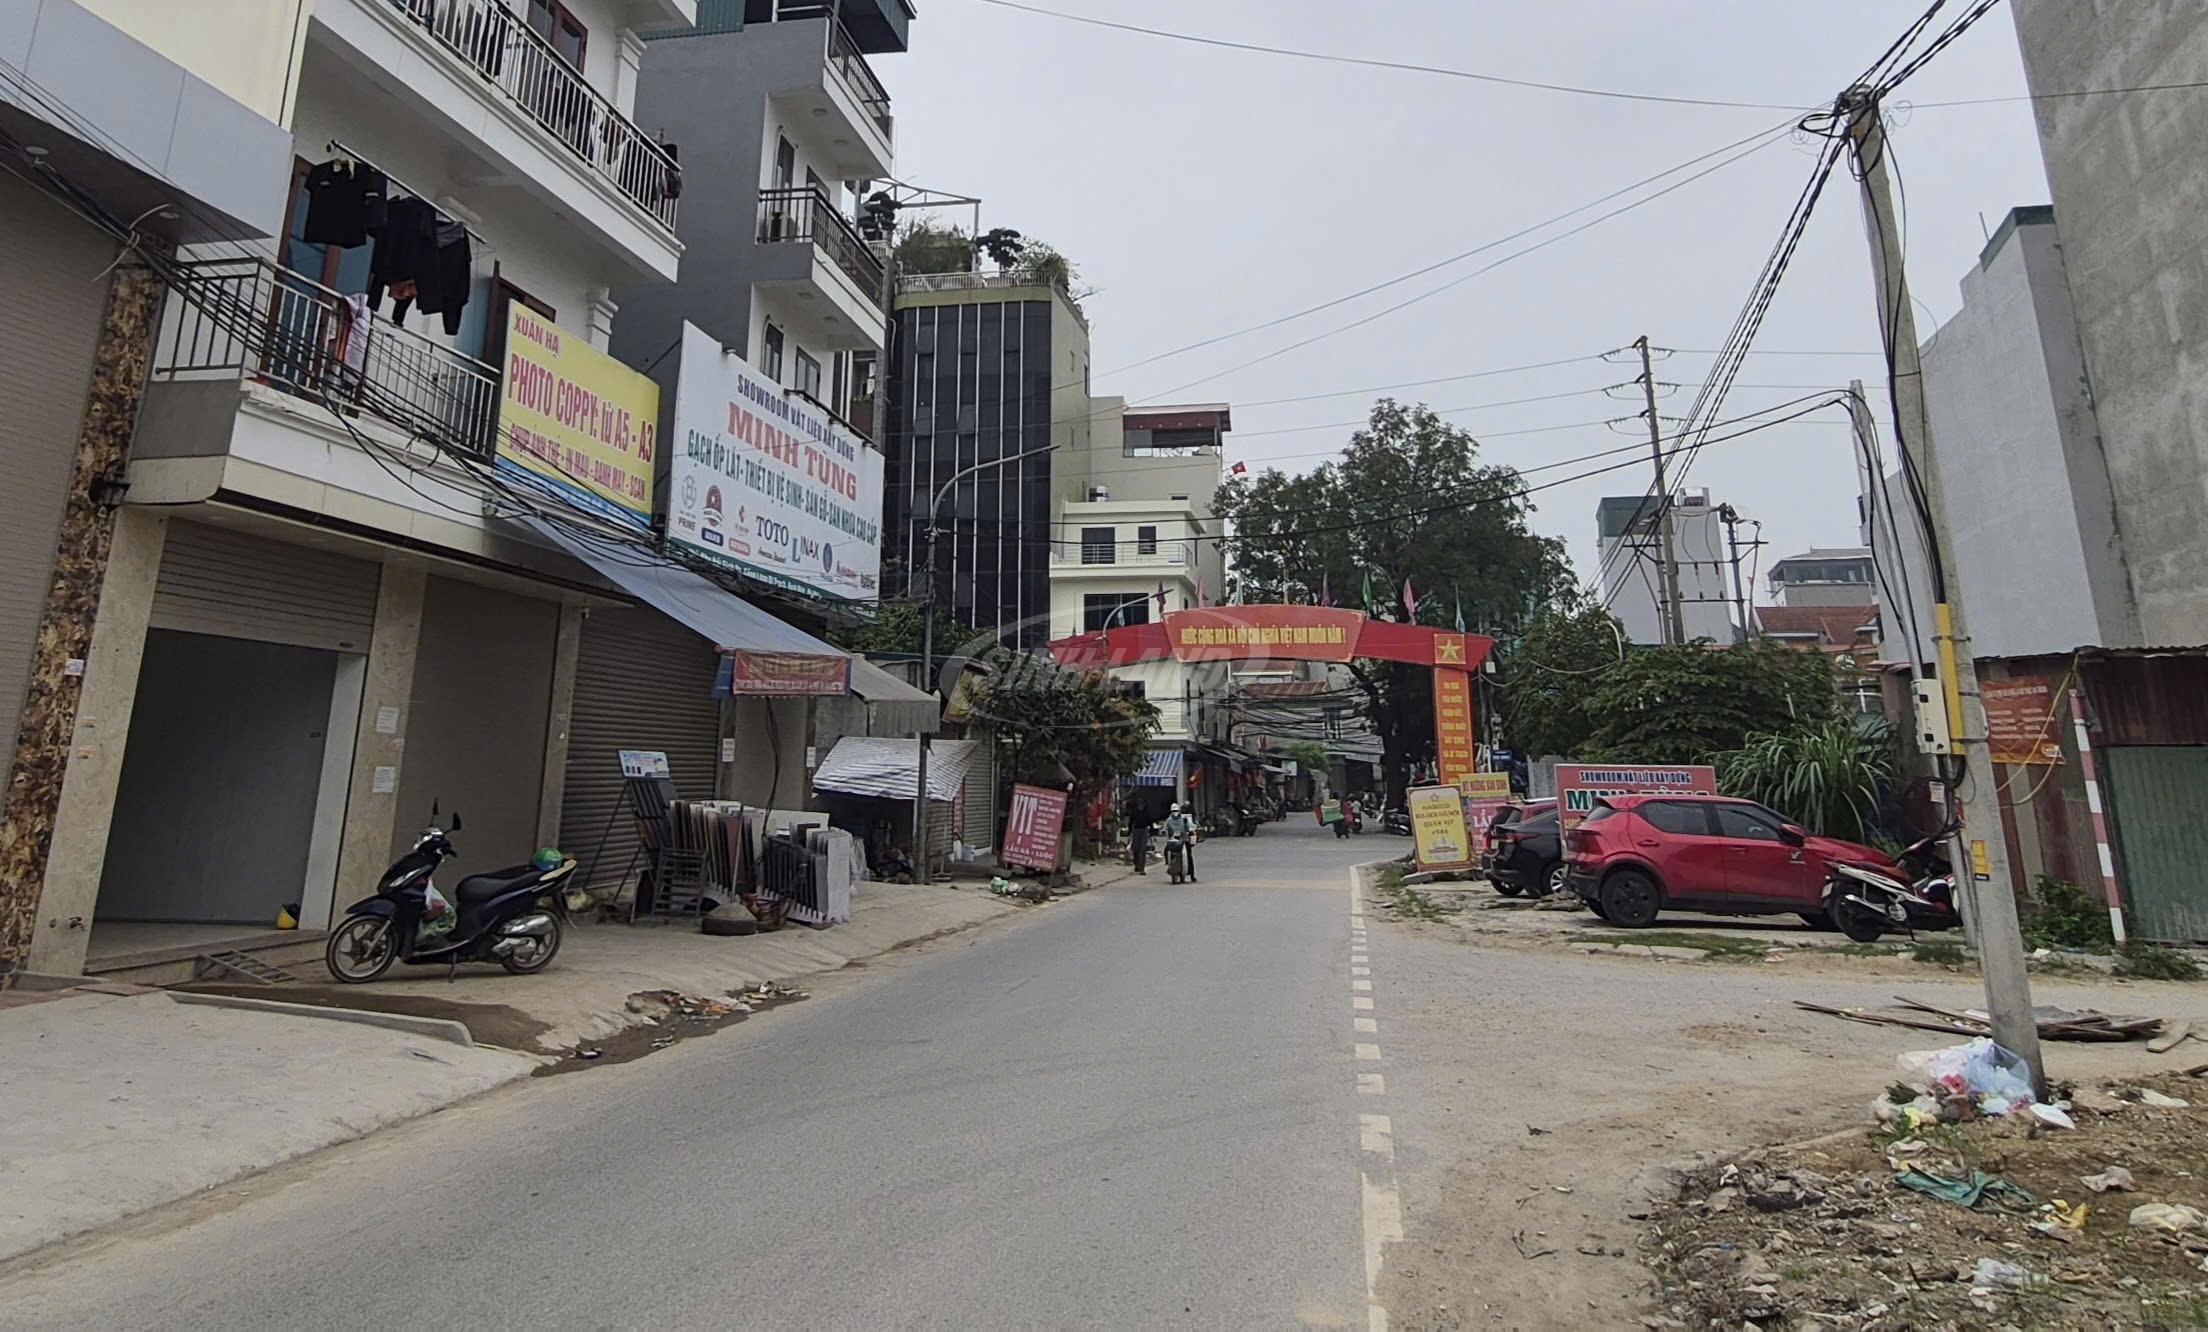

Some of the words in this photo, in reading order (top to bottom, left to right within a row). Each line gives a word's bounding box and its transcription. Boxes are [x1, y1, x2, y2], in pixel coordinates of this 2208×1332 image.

[514, 313, 543, 345] XUÂN
[545, 331, 559, 358] HẠ
[508, 353, 553, 416] PHOTO
[556, 378, 598, 438] COPPY:
[614, 408, 630, 452] A5
[638, 420, 654, 463] A3
[738, 374, 789, 421] SHOWROOM
[790, 406, 805, 431] VẬT
[688, 429, 712, 468] GẠCH
[713, 433, 725, 472] ỐP
[728, 401, 800, 469] MINH
[804, 445, 857, 501] TÙNG
[756, 515, 789, 547] TOTO
[1580, 771, 1624, 784] SHOWROOM
